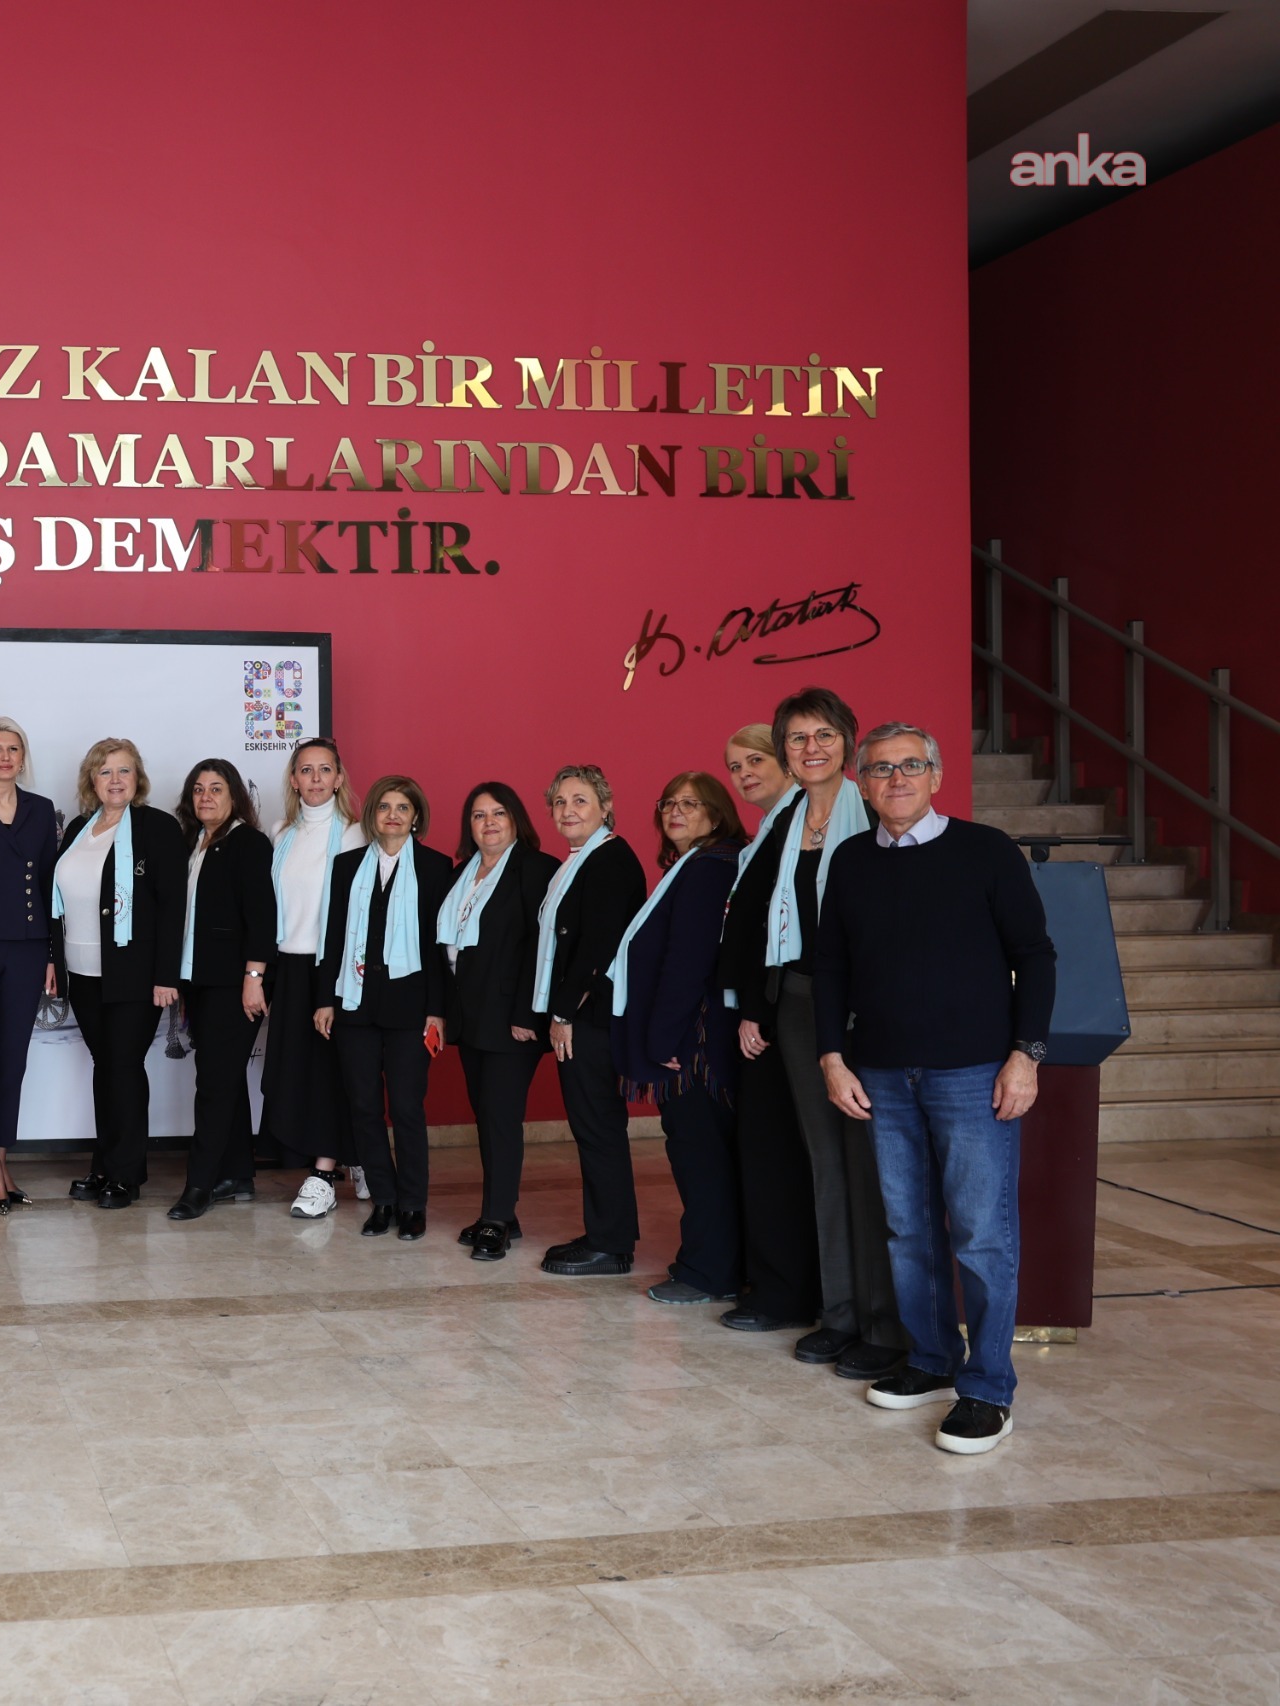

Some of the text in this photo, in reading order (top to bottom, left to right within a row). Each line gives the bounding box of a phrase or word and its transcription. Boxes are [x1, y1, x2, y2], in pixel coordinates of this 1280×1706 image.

[61, 346, 356, 405] KALAN
[367, 340, 503, 409] BİR
[514, 345, 884, 418] MİLLETİN
[698, 433, 856, 501] BİRİ
[33, 507, 501, 576] DEMEKTİR.
[244, 740, 287, 752] ESKİŞEHİR
